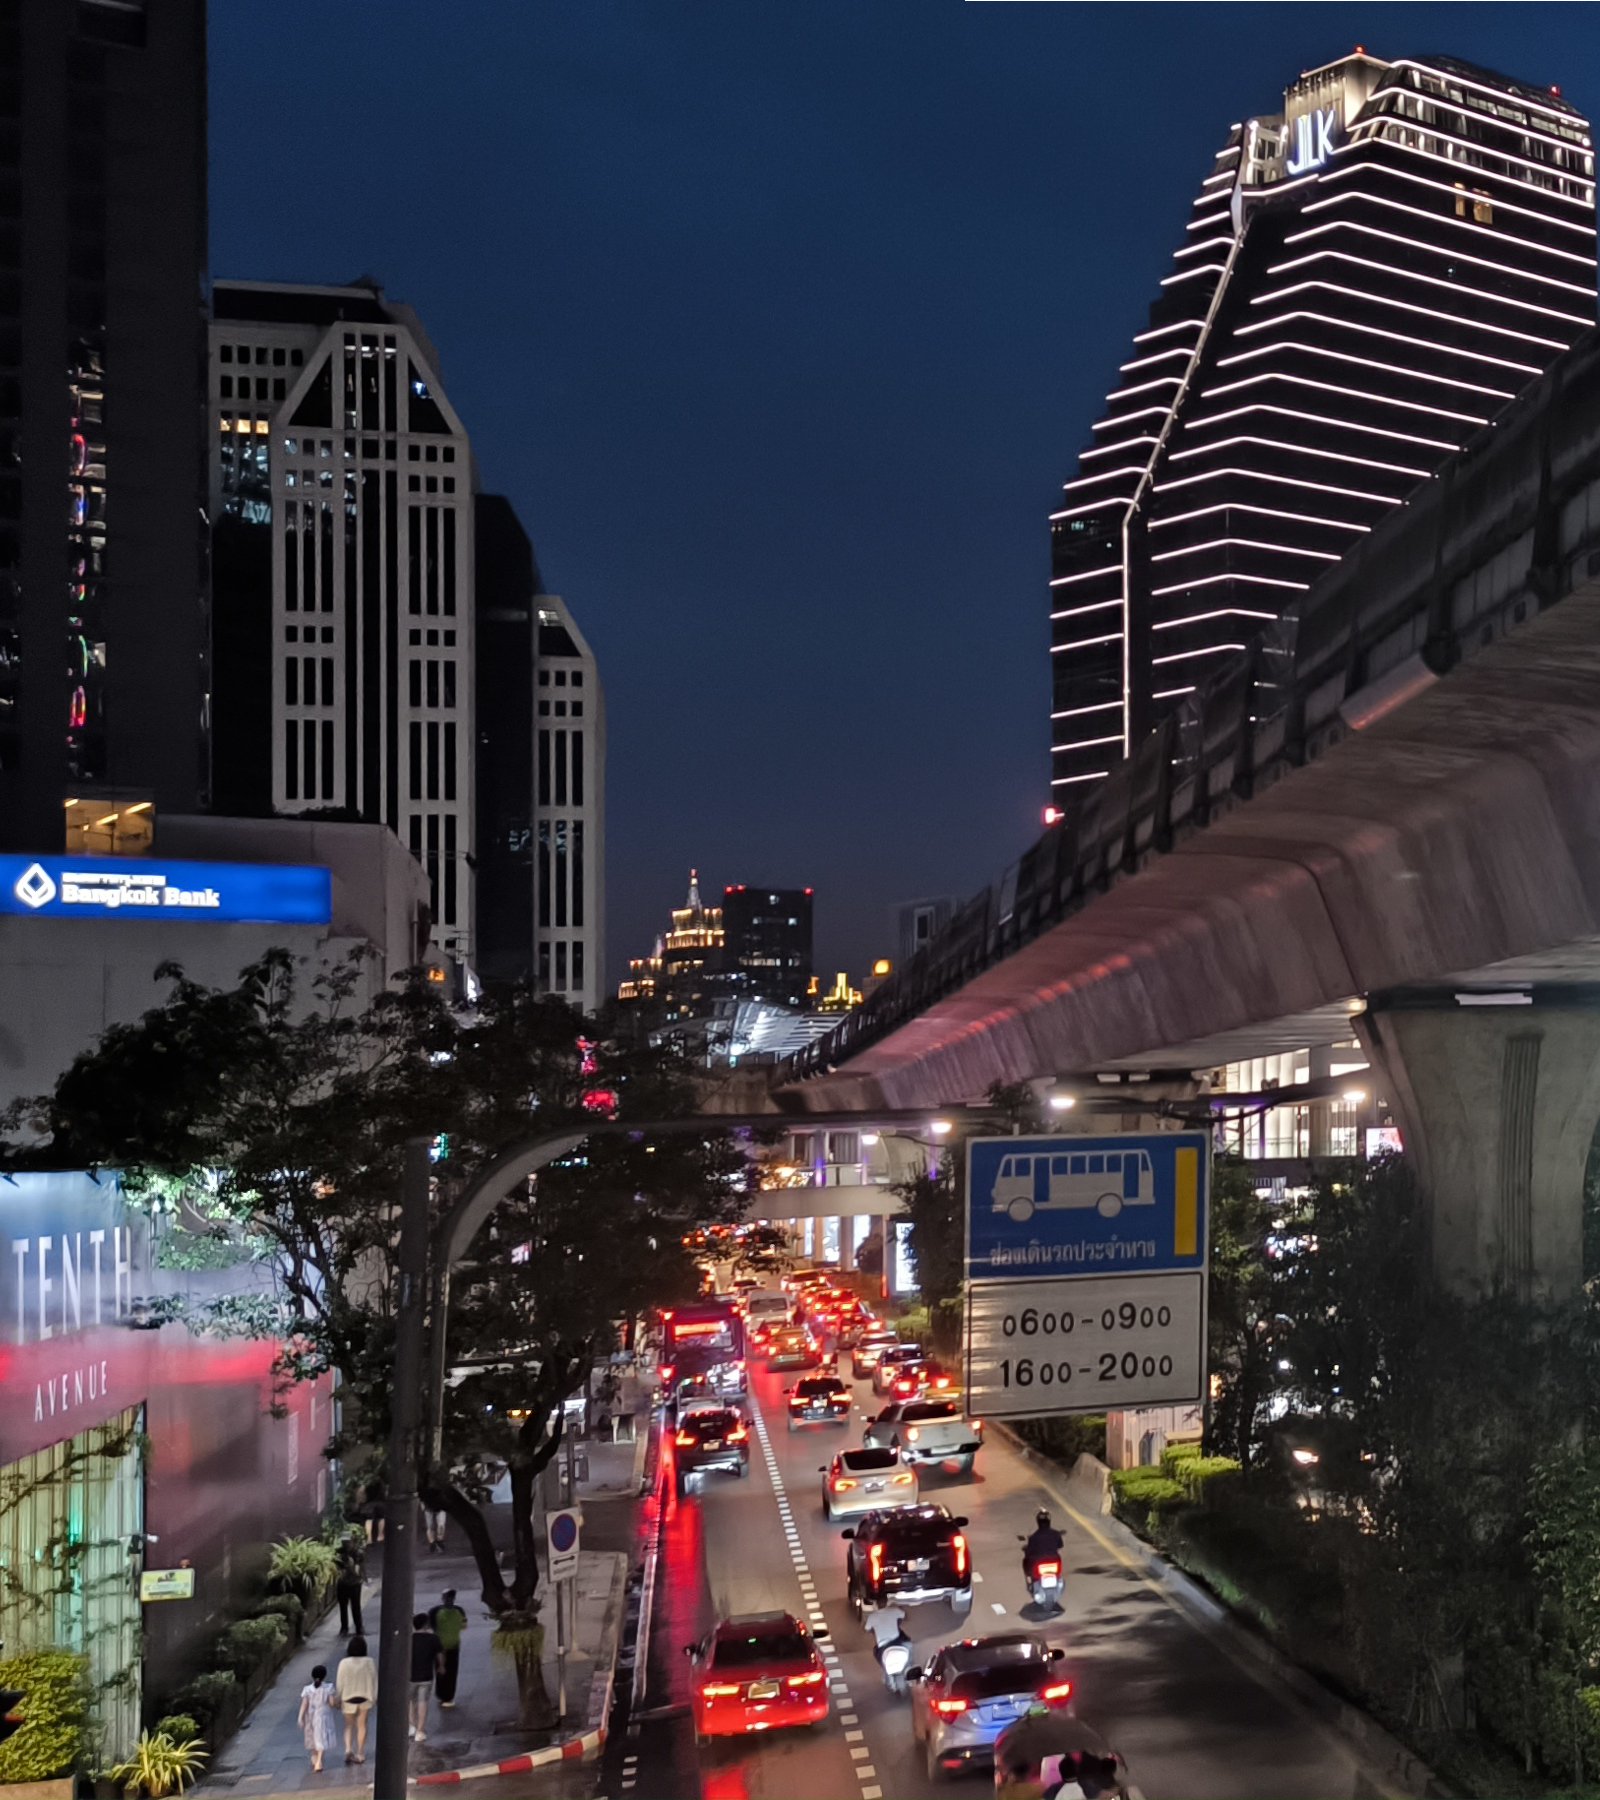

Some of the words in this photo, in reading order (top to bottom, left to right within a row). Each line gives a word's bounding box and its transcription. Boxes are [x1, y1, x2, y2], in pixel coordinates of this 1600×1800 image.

[61, 884, 160, 908] Bangkok
[164, 887, 220, 907] Bank
[990, 1234, 1156, 1266] ช่องเดินรถประจำทาง
[12, 1226, 131, 1345] TENTH
[34, 1360, 107, 1423] AVENUE
